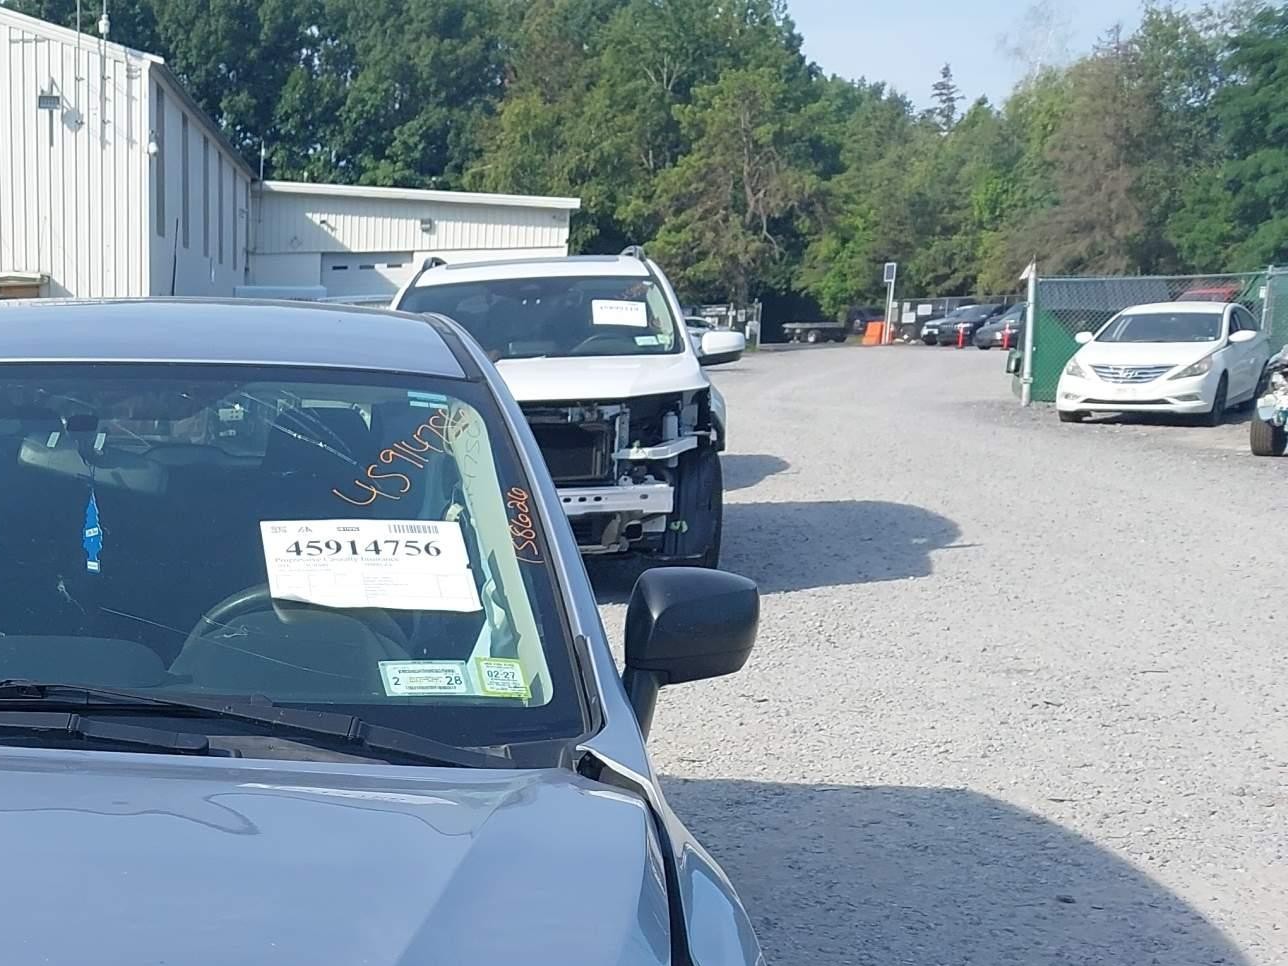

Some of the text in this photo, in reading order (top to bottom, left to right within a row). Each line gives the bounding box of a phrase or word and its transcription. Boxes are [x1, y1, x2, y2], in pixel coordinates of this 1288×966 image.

[286, 539, 441, 557] 45914756
[487, 670, 515, 679] 02-27
[392, 676, 401, 686] 2
[445, 675, 463, 686] 28
